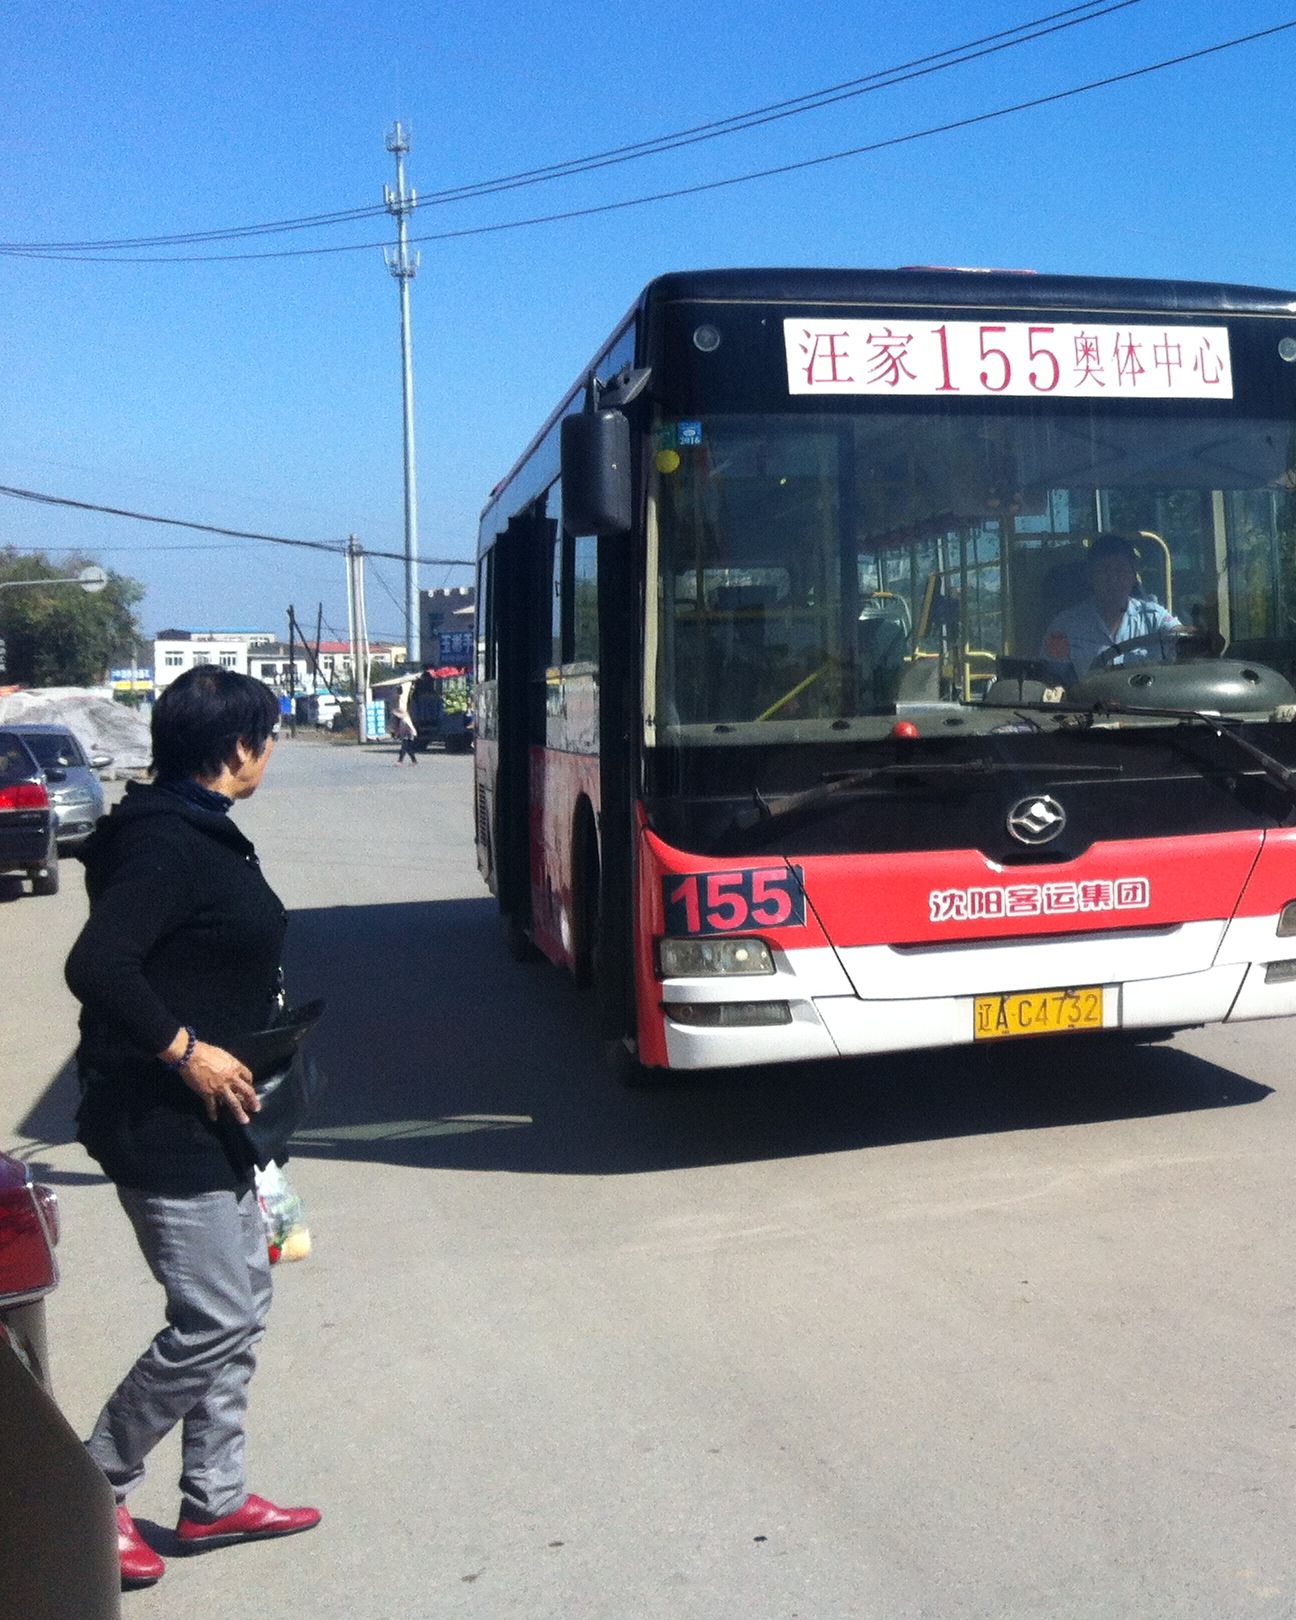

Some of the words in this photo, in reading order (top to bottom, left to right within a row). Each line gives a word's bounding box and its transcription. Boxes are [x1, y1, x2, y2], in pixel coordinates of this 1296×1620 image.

[799, 327, 917, 385] 汪家
[931, 325, 1060, 392] 155
[1073, 329, 1224, 388] 奥体中心
[672, 869, 793, 932] 155
[929, 877, 1151, 922] 沈阳客运集团
